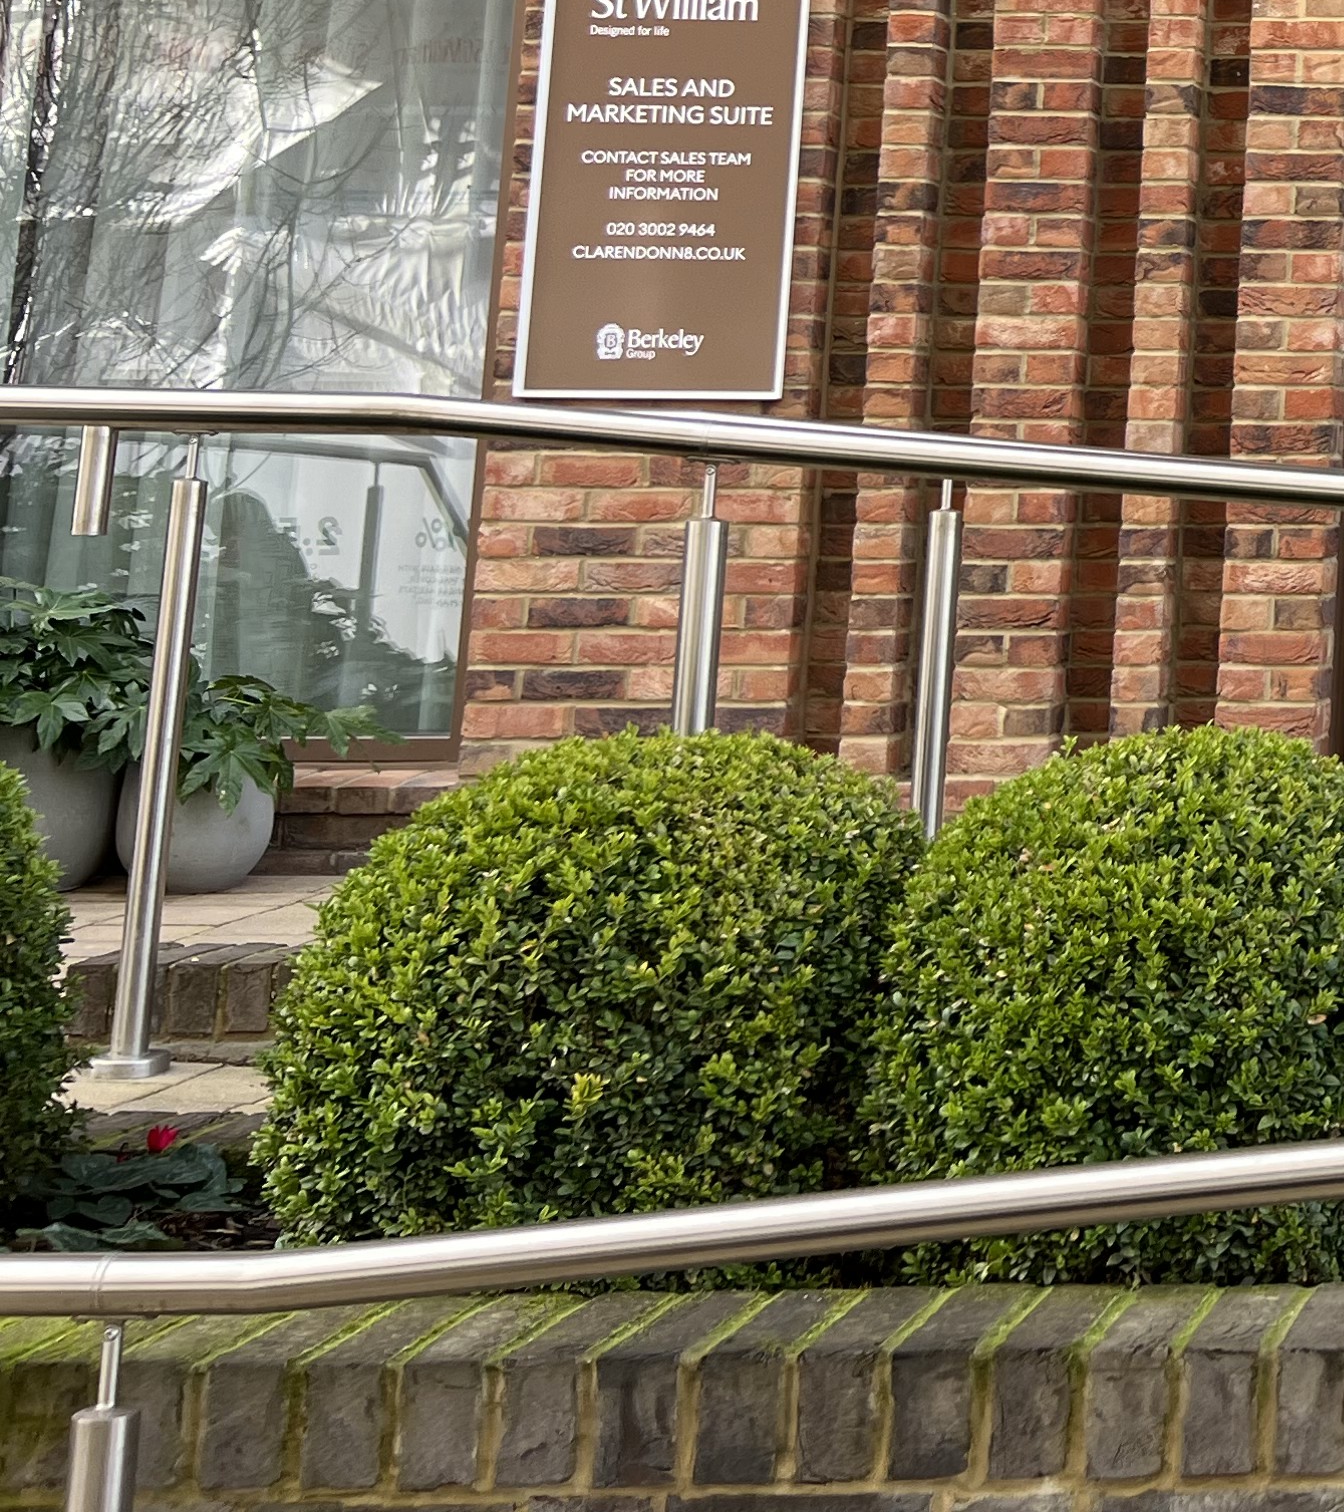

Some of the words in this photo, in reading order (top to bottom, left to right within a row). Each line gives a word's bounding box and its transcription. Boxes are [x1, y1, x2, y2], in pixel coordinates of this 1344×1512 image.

[590, 24, 635, 38] Designed
[637, 25, 652, 37] for
[653, 25, 670, 37] life
[609, 76, 678, 97] SALES
[681, 78, 736, 98] AND
[566, 103, 705, 124] MARKETING
[709, 106, 774, 126] SUITE
[581, 150, 658, 165] CONTACT
[660, 151, 706, 166] SALES
[709, 152, 752, 166] TEAM
[625, 168, 656, 183] FOR
[659, 169, 706, 183] MORE
[609, 186, 719, 201] INFORMATION
[606, 222, 635, 236] 020
[638, 222, 676, 237] 3002
[678, 223, 716, 237] 9464
[572, 245, 746, 261] CLARENDONN8.CO.UK
[628, 328, 704, 356] Berkeley
[626, 348, 656, 360] Group
